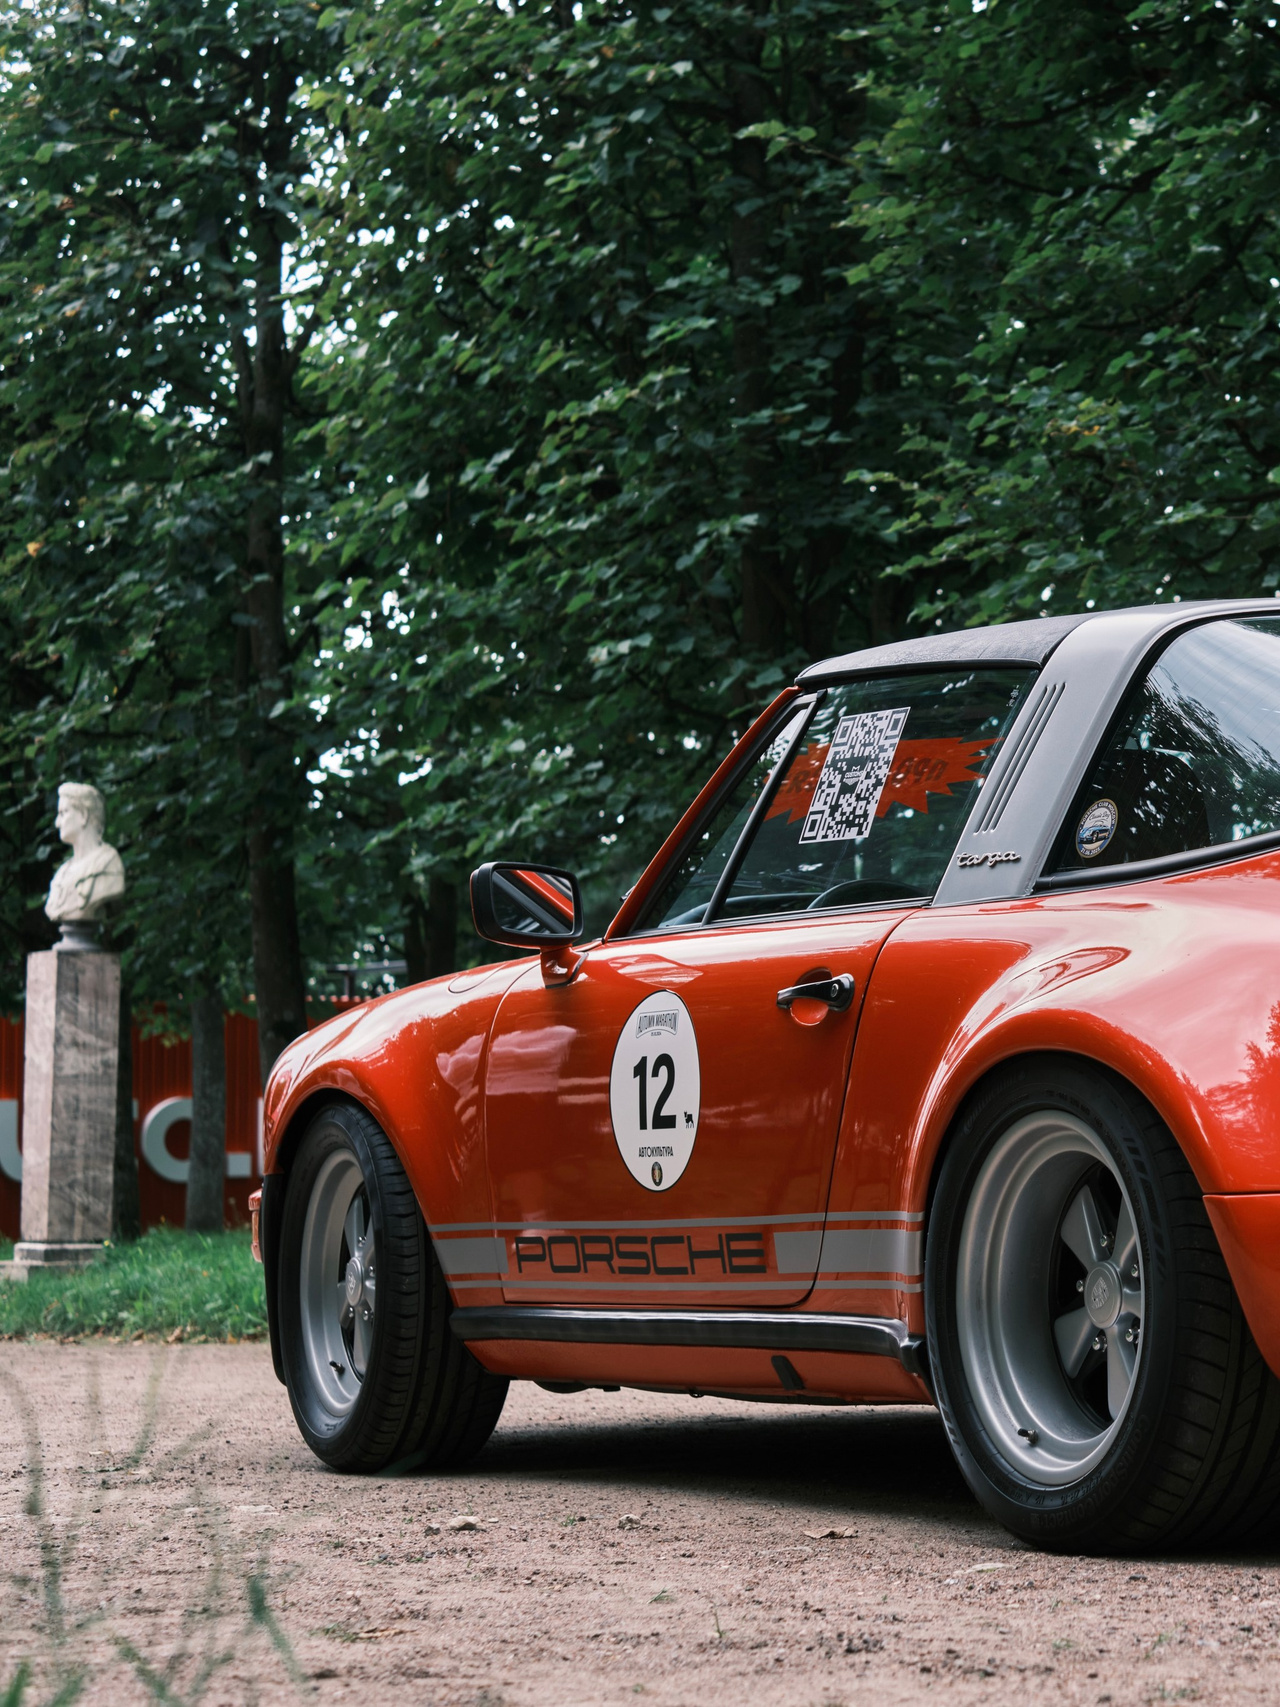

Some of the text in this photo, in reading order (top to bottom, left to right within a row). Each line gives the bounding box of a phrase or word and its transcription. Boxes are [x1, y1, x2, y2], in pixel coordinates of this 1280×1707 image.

[956, 851, 1022, 867] targa
[655, 1012, 677, 1032] MARATHON
[633, 1053, 677, 1131] 12
[638, 1146, 674, 1158] АВТОКУЛЬТУРА
[514, 1232, 768, 1275] PORSCHE
